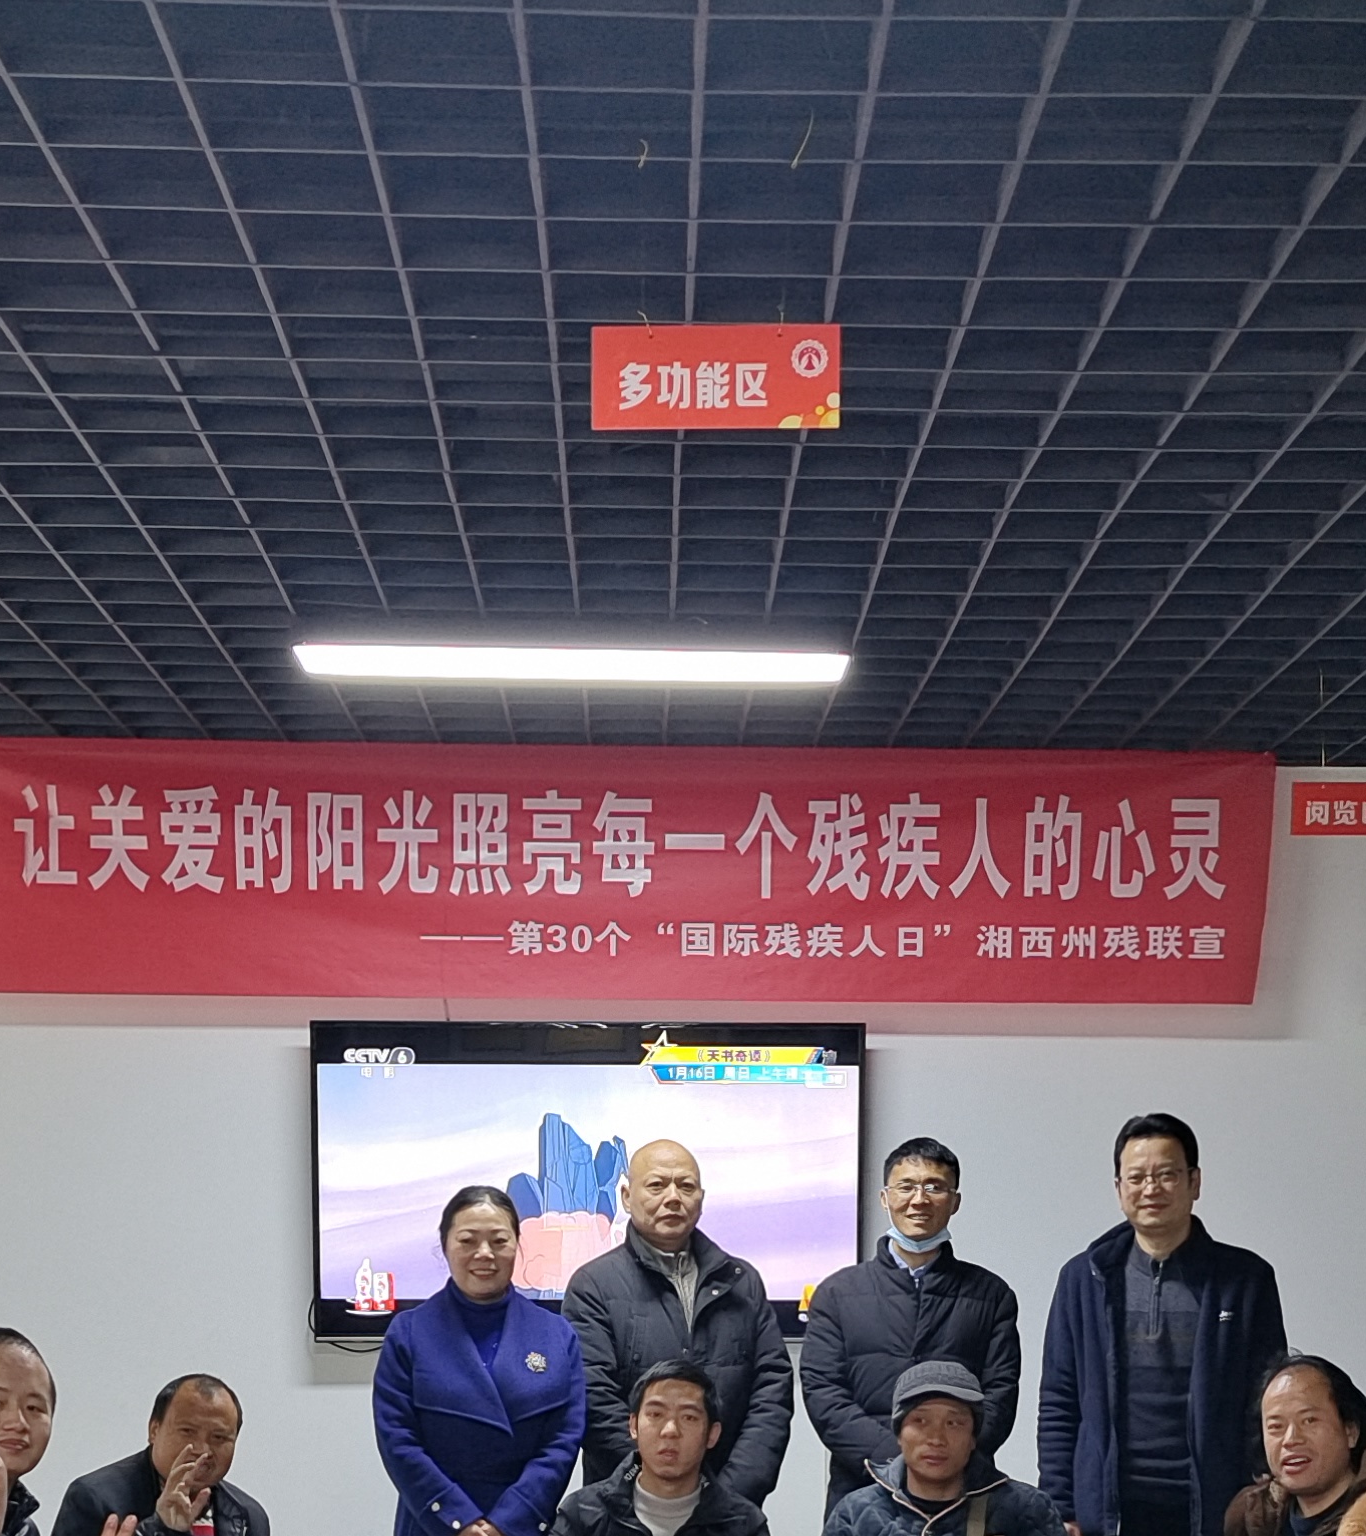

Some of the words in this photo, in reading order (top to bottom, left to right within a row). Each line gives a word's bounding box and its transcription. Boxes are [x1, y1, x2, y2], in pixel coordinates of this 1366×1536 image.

[618, 361, 768, 410] 多功能区
[13, 783, 1227, 901] 让关爱的阳光照亮每一个残疾人的心灵
[975, 924, 1227, 960] 湘西州残联宣
